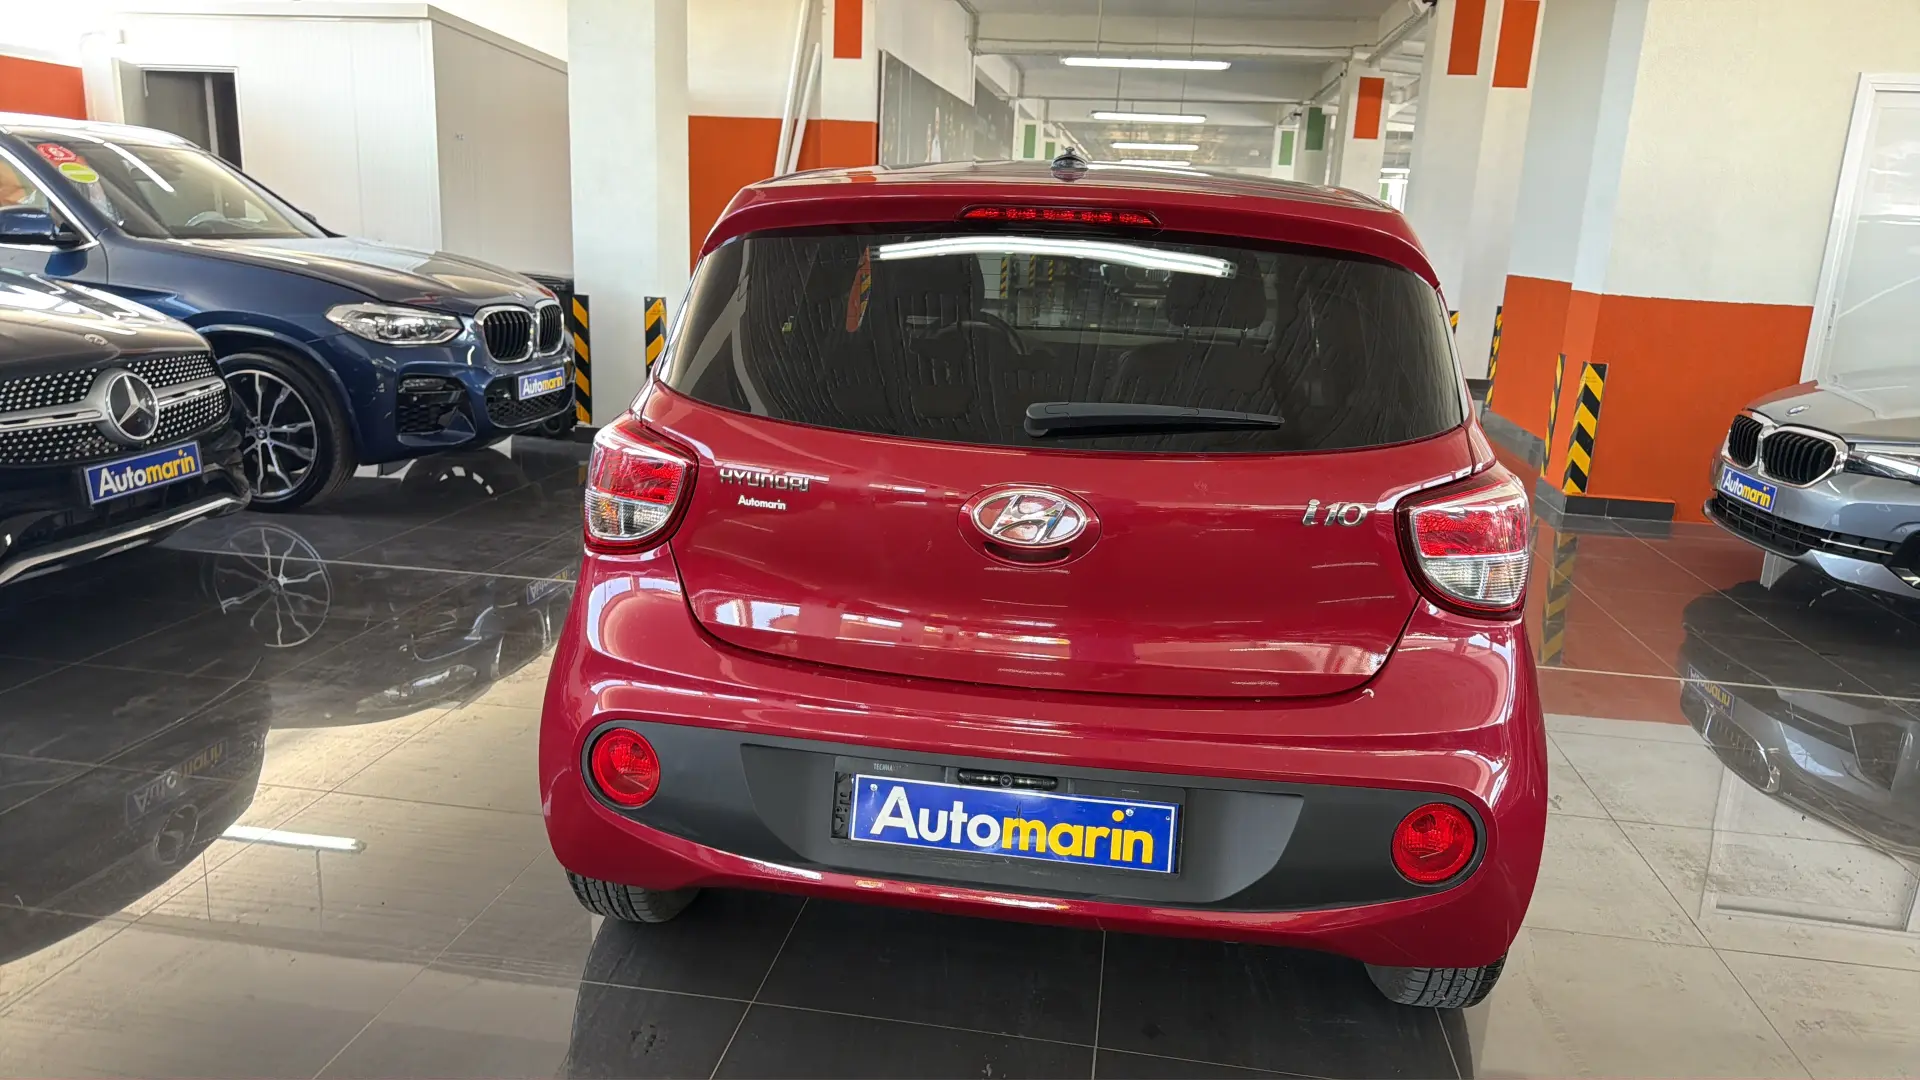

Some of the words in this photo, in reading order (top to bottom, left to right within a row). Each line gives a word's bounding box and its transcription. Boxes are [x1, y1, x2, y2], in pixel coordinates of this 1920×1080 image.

[522, 372, 563, 396] Automarin
[99, 449, 196, 497] Automarin
[719, 468, 809, 491] HYUNDAI
[738, 494, 786, 510] Automarin
[1723, 470, 1771, 508] Automarin
[869, 785, 1154, 864] Automarin
